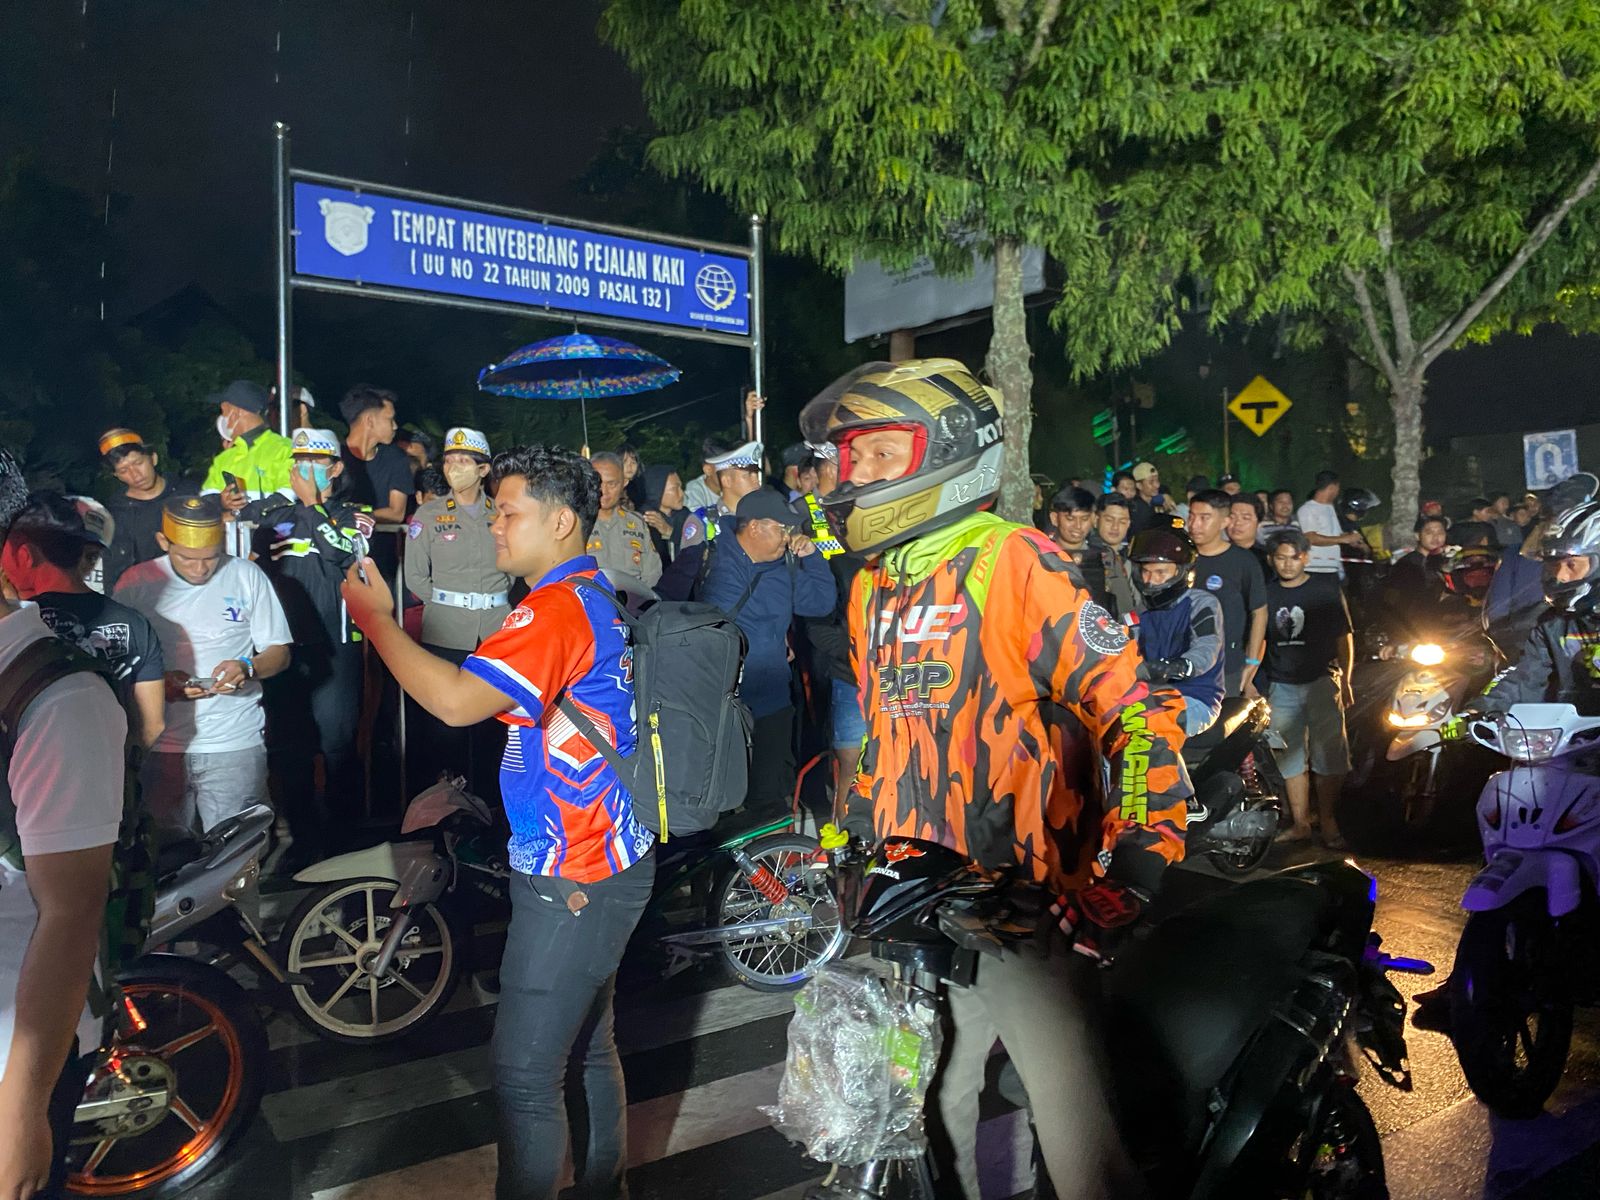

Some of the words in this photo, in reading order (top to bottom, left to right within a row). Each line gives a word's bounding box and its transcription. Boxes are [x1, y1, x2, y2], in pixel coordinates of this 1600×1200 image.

[391, 208, 456, 250] TEMPAT
[462, 221, 579, 270] MENYEBERANG
[584, 241, 647, 281] PEJALAN
[652, 254, 685, 287] KAKI
[423, 252, 445, 277] UU
[450, 256, 473, 280] NO
[483, 261, 499, 284] 22
[503, 264, 551, 292] TAHUN
[555, 273, 590, 298] 2009
[599, 279, 638, 305] PASAL
[641, 286, 663, 309] 132
[860, 492, 931, 543] RC
